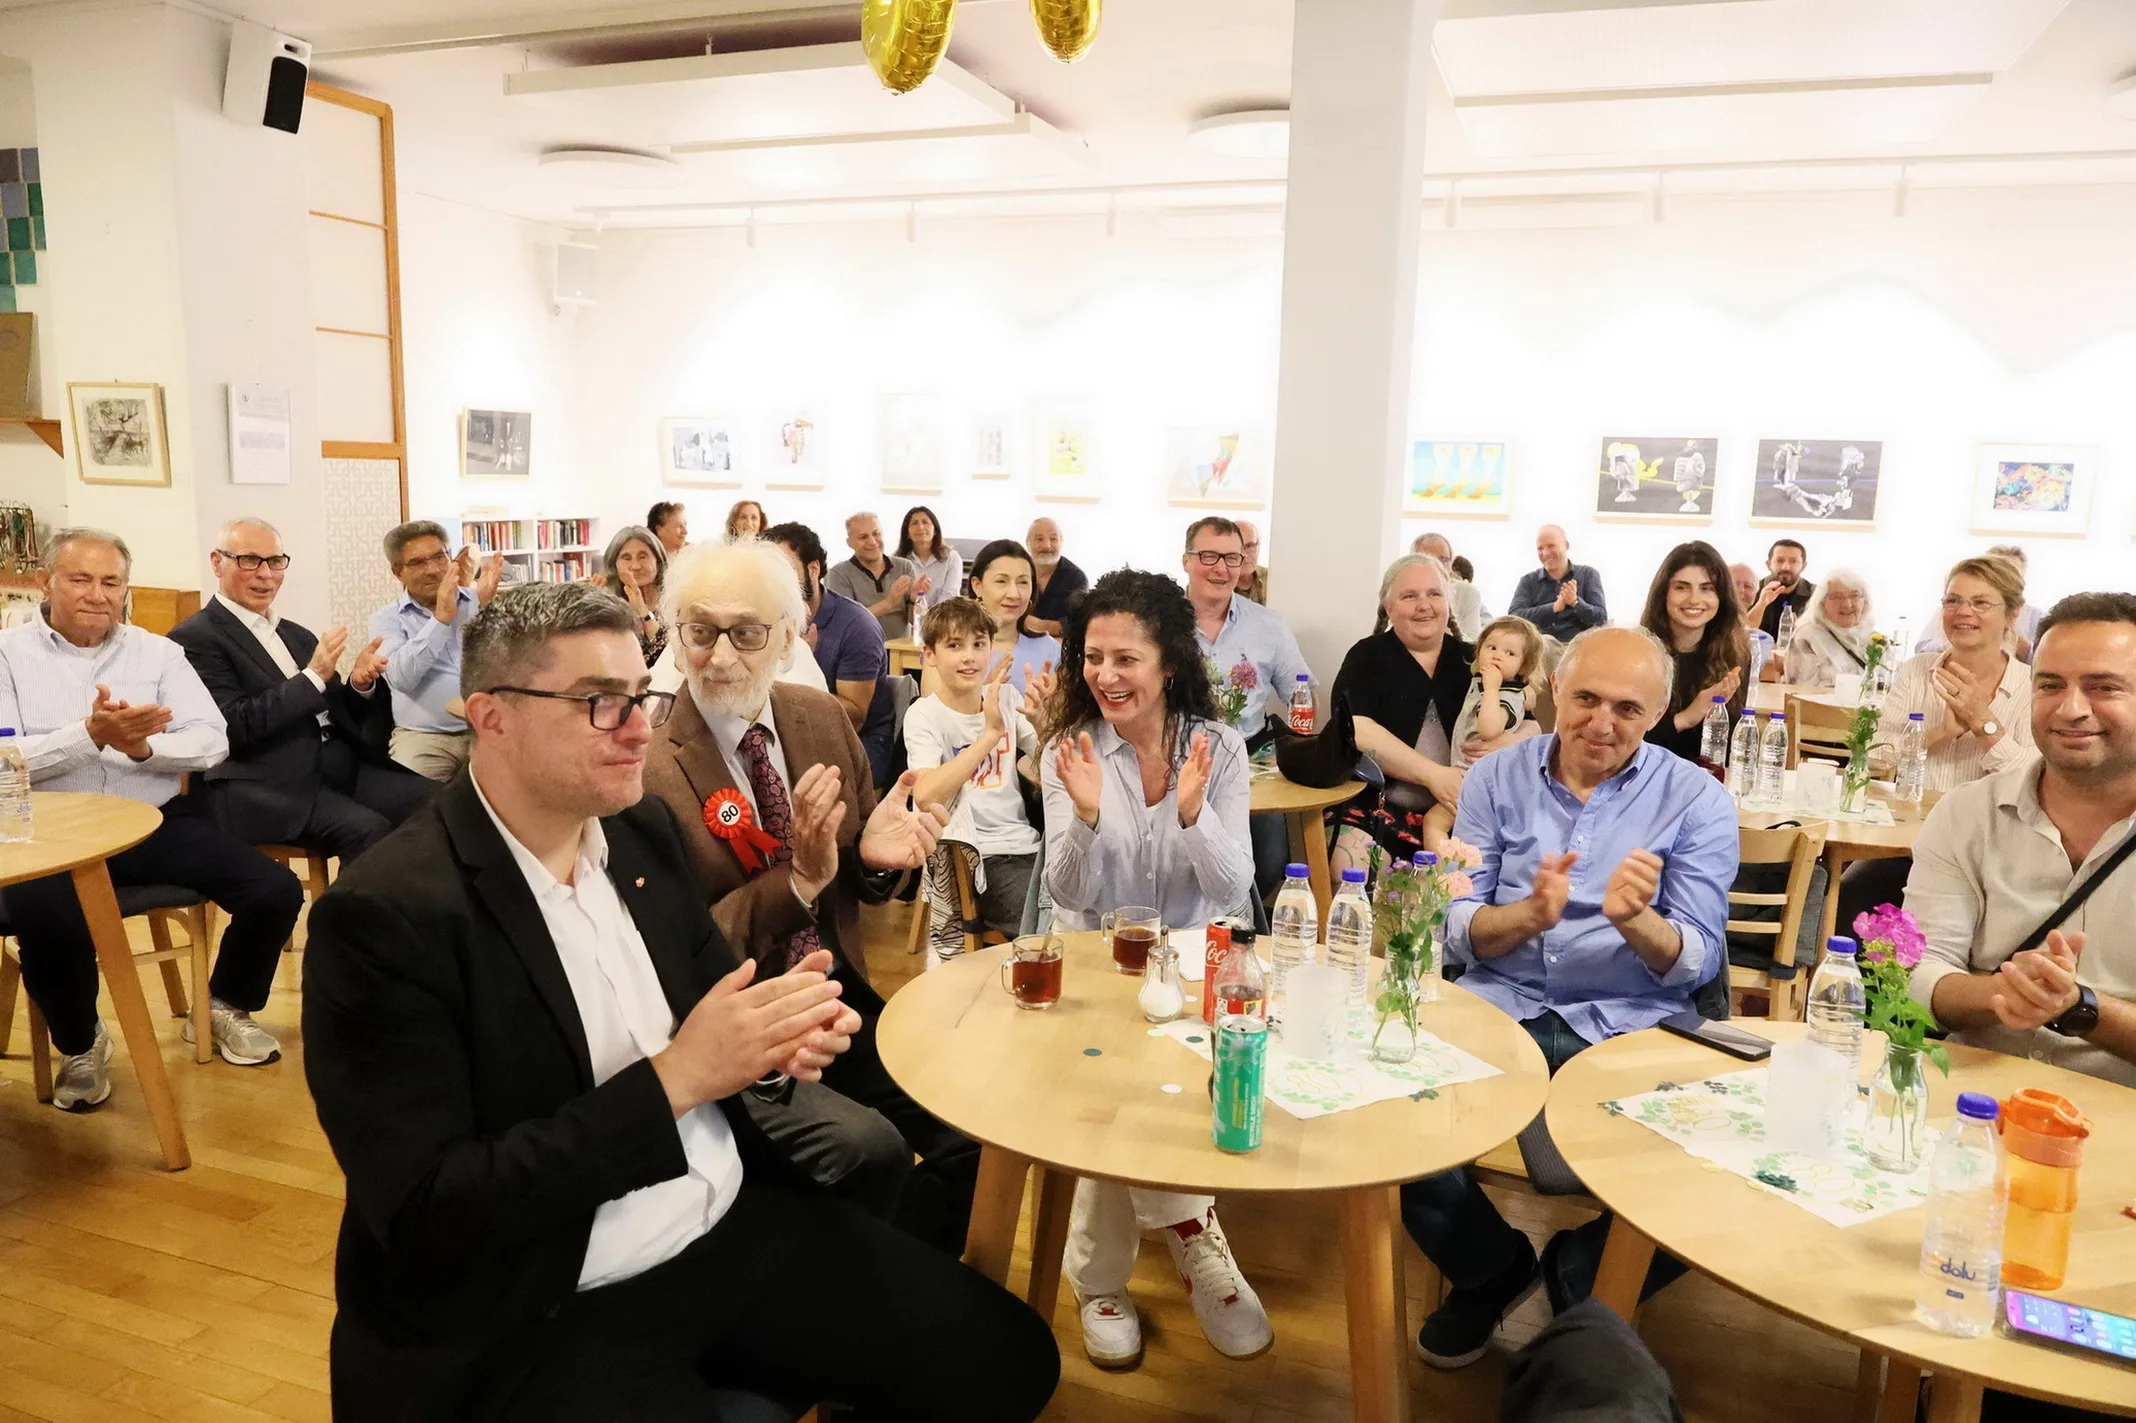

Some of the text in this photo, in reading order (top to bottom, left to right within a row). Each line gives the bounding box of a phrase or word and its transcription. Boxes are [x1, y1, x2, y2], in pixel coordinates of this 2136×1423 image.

[1291, 714, 1313, 730] Coca
[720, 804, 739, 823] 80
[1206, 940, 1227, 967] Coc
[1286, 1069, 1341, 1094] 80
[1940, 1257, 1976, 1281] dalu
